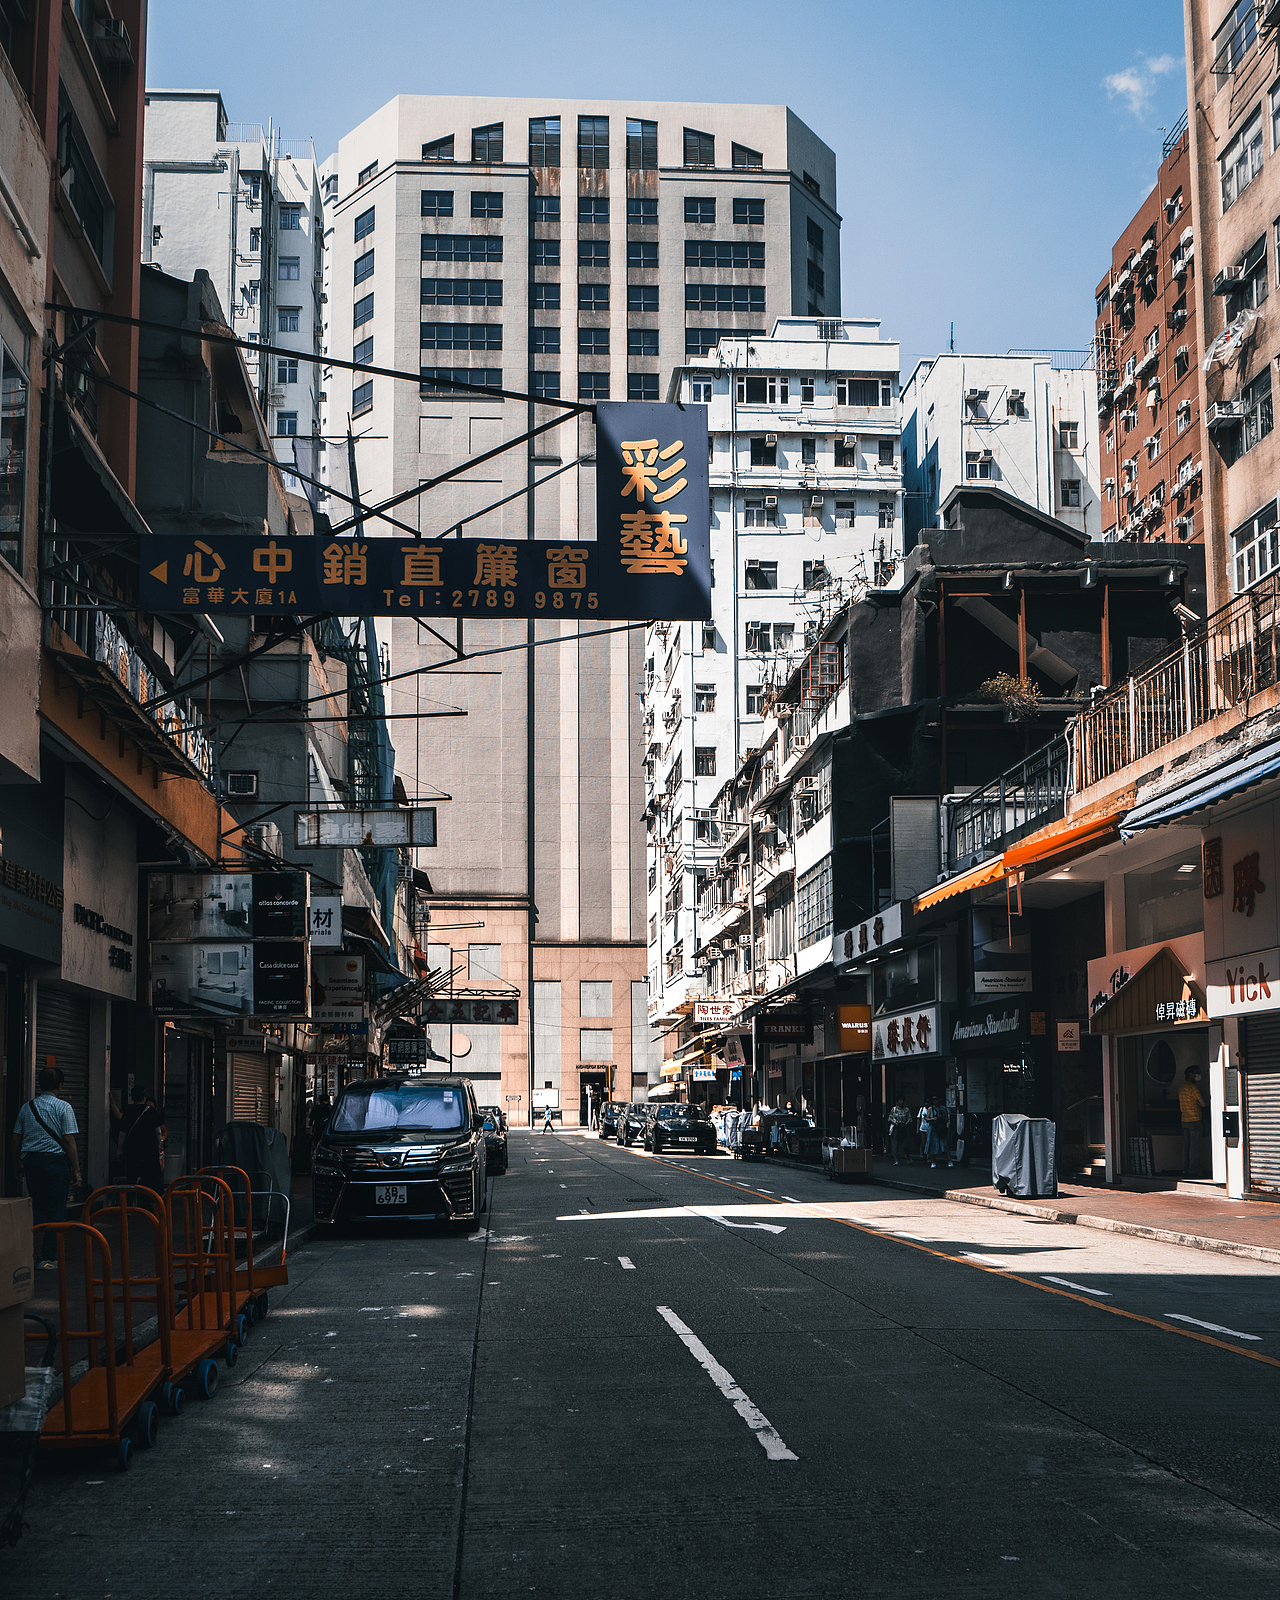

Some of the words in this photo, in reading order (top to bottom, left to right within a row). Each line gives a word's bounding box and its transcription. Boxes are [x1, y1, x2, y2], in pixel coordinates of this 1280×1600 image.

[619, 438, 688, 576] 彩藝
[184, 587, 297, 606] 富華大廈1A
[383, 590, 441, 607] Tel:
[452, 590, 515, 608] 2789
[535, 590, 598, 608] 9875
[313, 908, 334, 928] 材
[1227, 962, 1272, 1005] Yick
[697, 1005, 733, 1015] 陶世家
[763, 1025, 806, 1033] FRANKE
[951, 1020, 984, 1041] American
[984, 1008, 1020, 1036] Standard
[377, 1195, 406, 1204] 6975
[384, 1187, 399, 1196] XB
